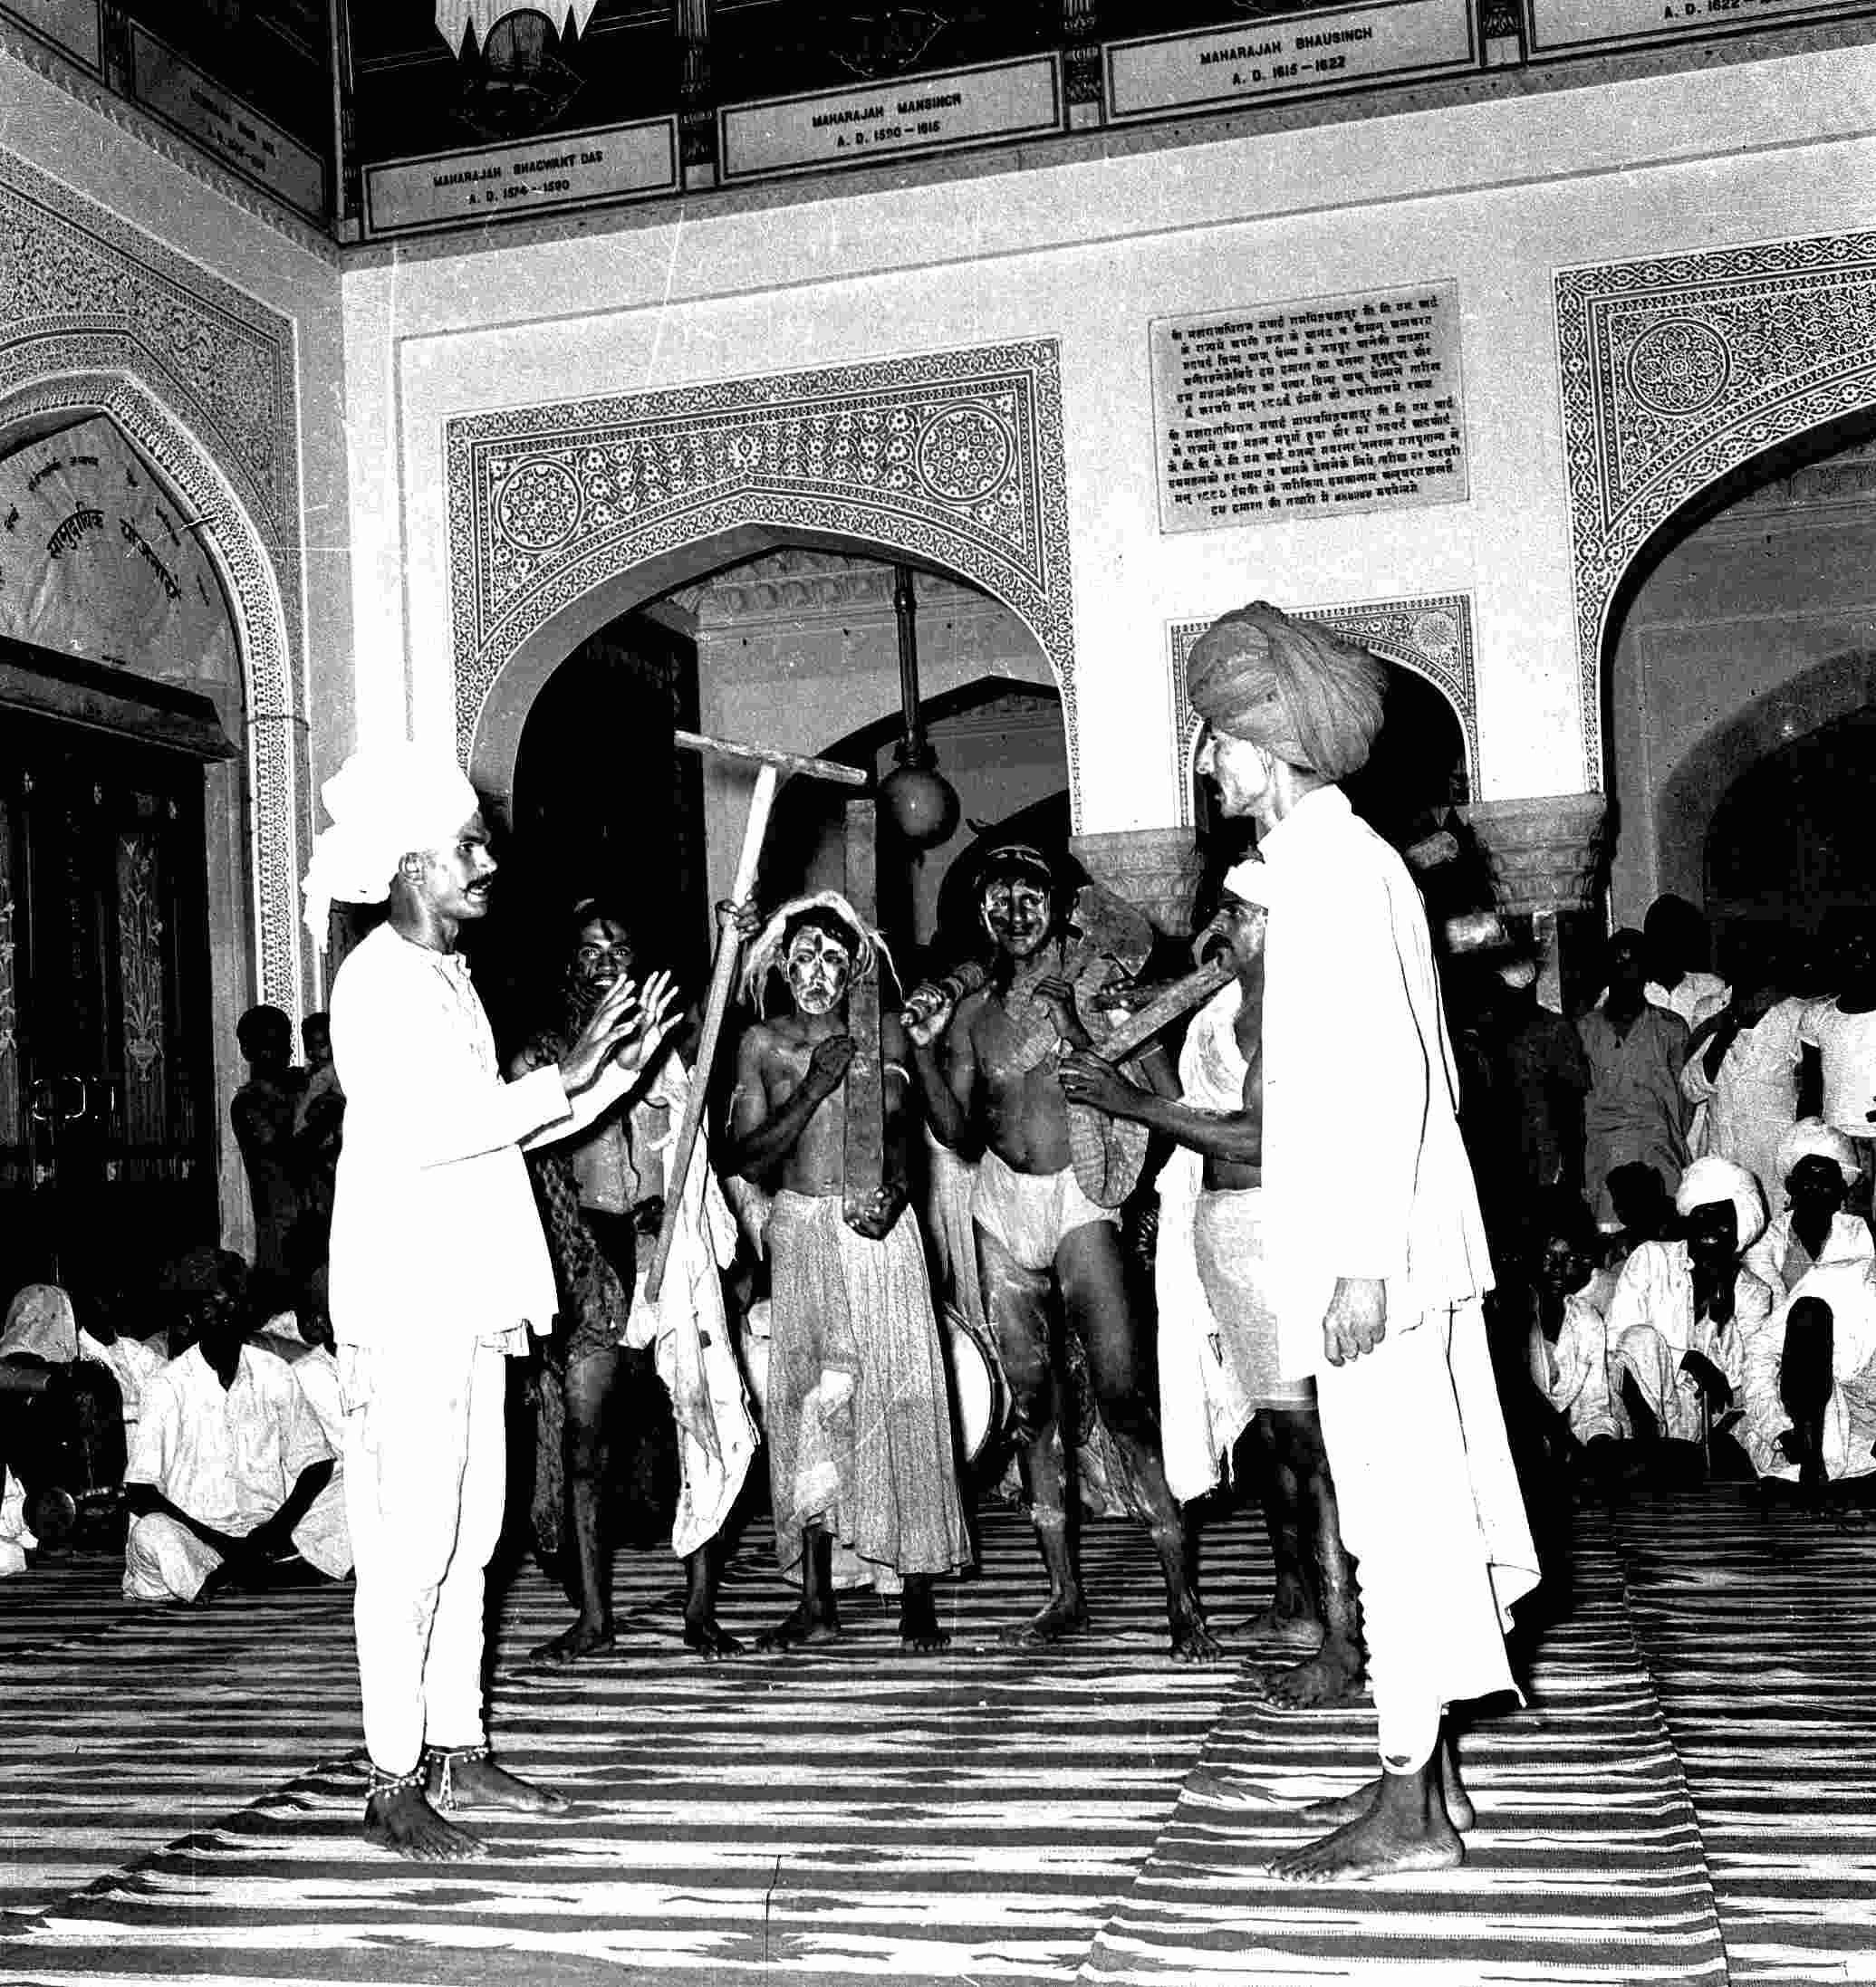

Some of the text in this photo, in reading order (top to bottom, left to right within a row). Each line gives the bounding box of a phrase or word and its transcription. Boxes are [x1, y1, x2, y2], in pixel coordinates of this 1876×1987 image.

[1200, 41, 1282, 64] MAHARAJAH
[812, 106, 884, 128] MAHARAJAH
[433, 166, 502, 187] MAHARAJAH
[581, 150, 603, 164] DAS
